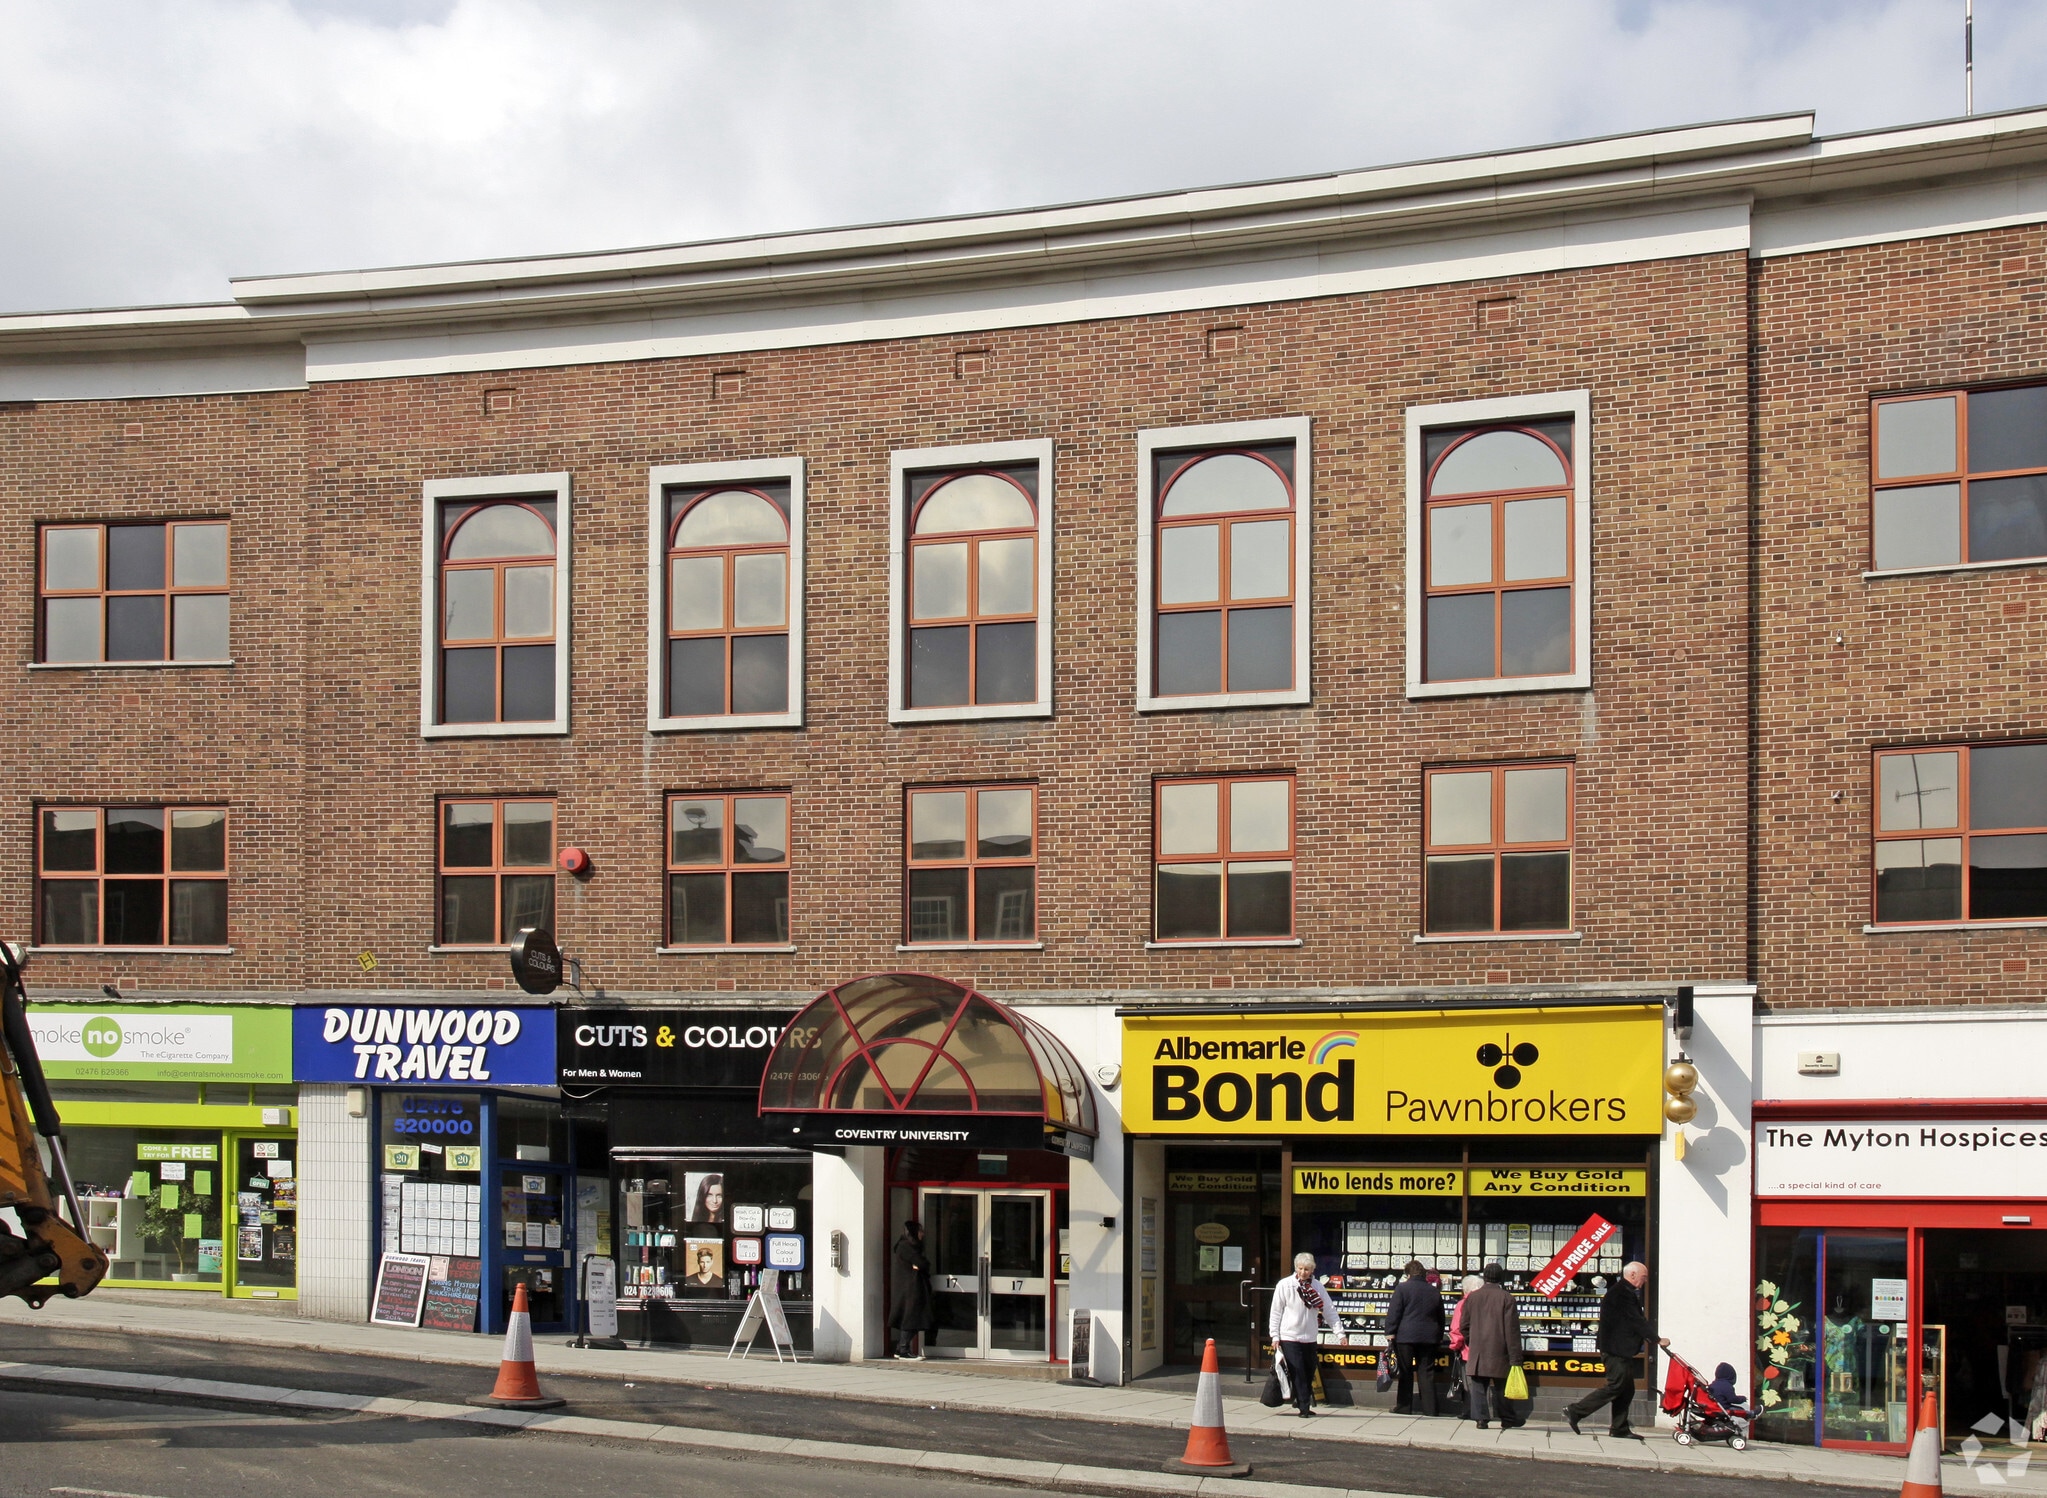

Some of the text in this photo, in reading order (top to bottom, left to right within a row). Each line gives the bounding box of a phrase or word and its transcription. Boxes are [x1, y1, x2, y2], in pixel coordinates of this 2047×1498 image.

[359, 952, 375, 969] H
[323, 1008, 521, 1046] DUNWOOD
[30, 1024, 80, 1043] moke
[87, 1029, 118, 1045] no
[574, 1025, 822, 1049] CUTS & COLOURS
[1154, 1036, 1306, 1061] Albemarle
[140, 1050, 230, 1061] The eCigarette Company
[353, 1044, 491, 1082] TRAVEL
[75, 1068, 129, 1077] 02476 629366
[157, 1070, 284, 1079] info@centralsmokenosmoke.com
[562, 1068, 642, 1078] For Men & Women
[1152, 1059, 1355, 1122] Bond
[402, 1097, 464, 1115] 02476
[1386, 1089, 1626, 1122] Pawnbrokers
[394, 1118, 473, 1135] 520000
[835, 1129, 970, 1141] COVENTRY UNIVERSITY
[1766, 1126, 2047, 1151] The Myton Hospices
[171, 1146, 212, 1159] FREE
[396, 1155, 407, 1164] 20
[457, 1156, 469, 1165] 20
[1175, 1174, 1253, 1183] We Buy Gold
[1301, 1171, 1456, 1191] Who lends more?
[1490, 1169, 1624, 1182] We Buy Gold
[252, 1180, 267, 1188] OPEN
[1170, 1182, 1257, 1191] Any Condition
[1483, 1181, 1631, 1194] Any Condition
[1788, 1181, 1823, 1190] special
[1825, 1181, 1845, 1190] kind
[1847, 1181, 1857, 1190] of
[1859, 1182, 1882, 1190] care
[1590, 1221, 1613, 1243] SALE
[1539, 1238, 1595, 1296] HALF PRICE
[946, 1277, 958, 1289] 17
[1011, 1280, 1024, 1291] 17
[623, 1285, 638, 1296] 024
[1564, 1359, 1606, 1373] Cas
